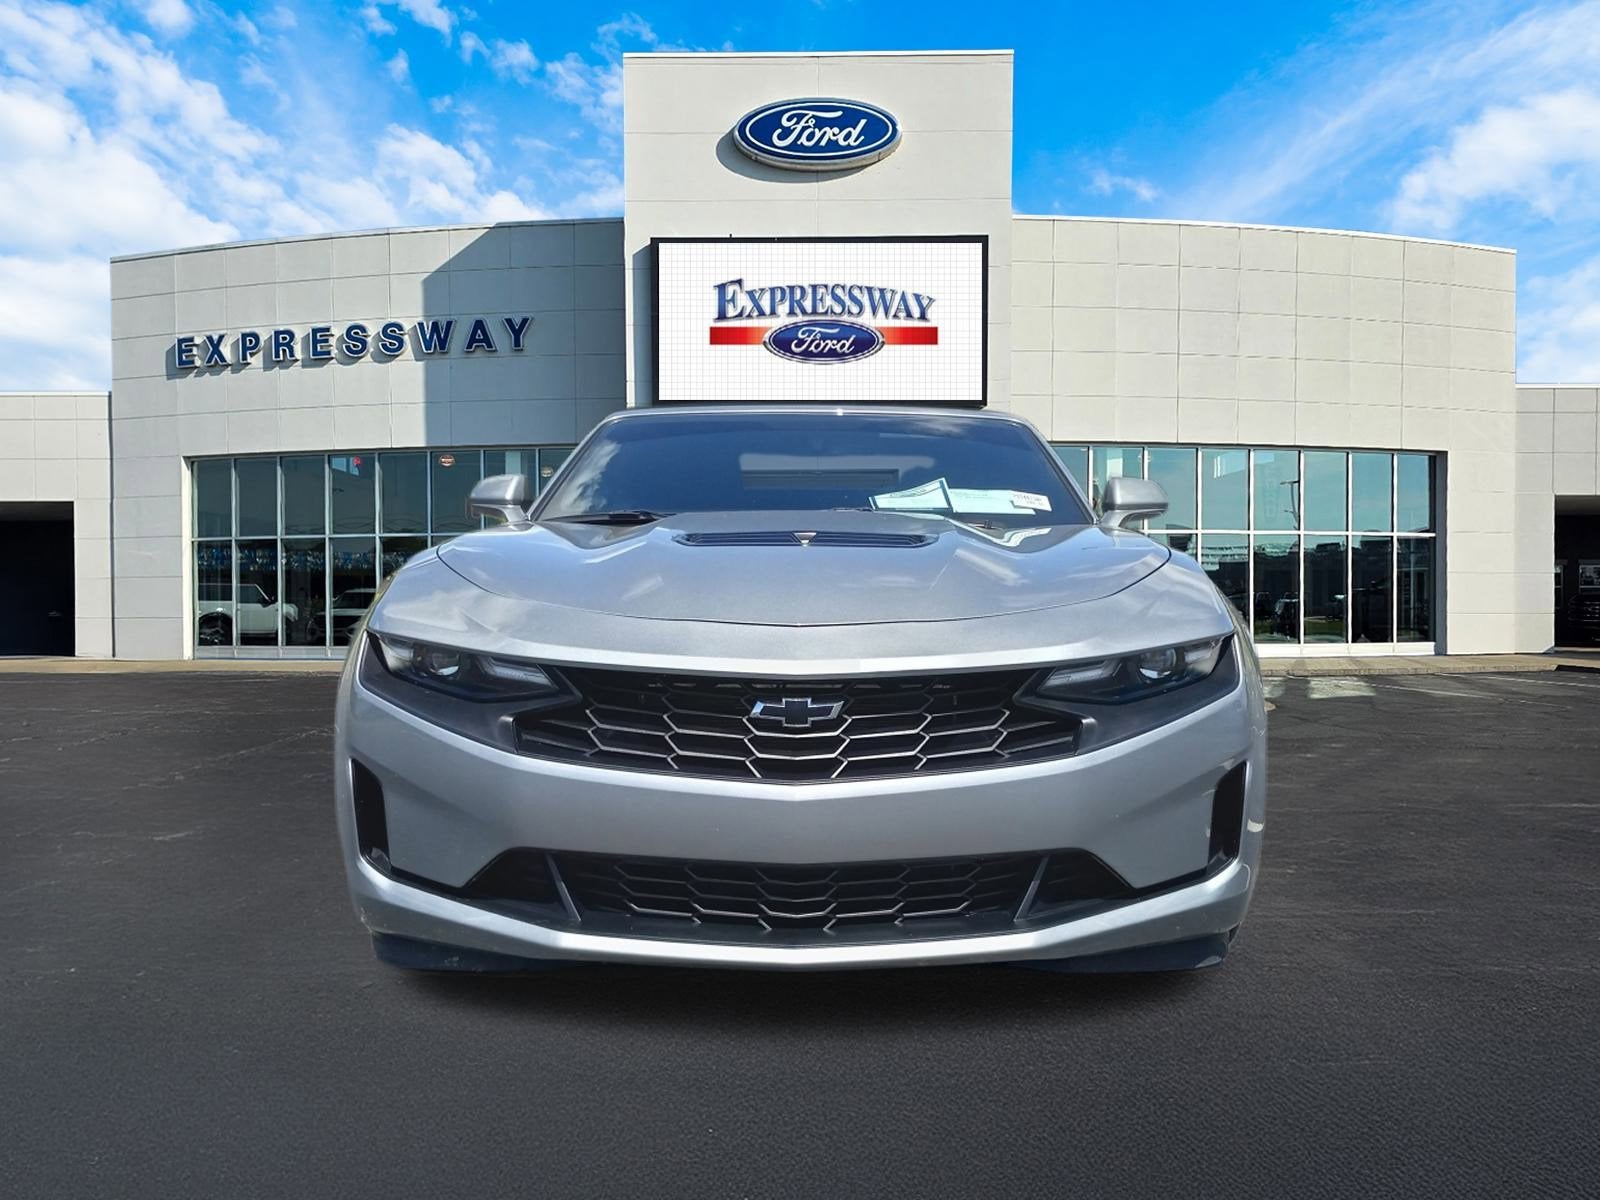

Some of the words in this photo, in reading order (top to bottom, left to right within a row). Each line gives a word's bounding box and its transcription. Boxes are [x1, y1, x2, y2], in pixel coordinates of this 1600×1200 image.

[771, 109, 867, 147] Ford
[713, 278, 935, 322] EXPRESSWAY
[175, 315, 533, 369] EXPRESSWAY
[790, 326, 855, 354] Ford
